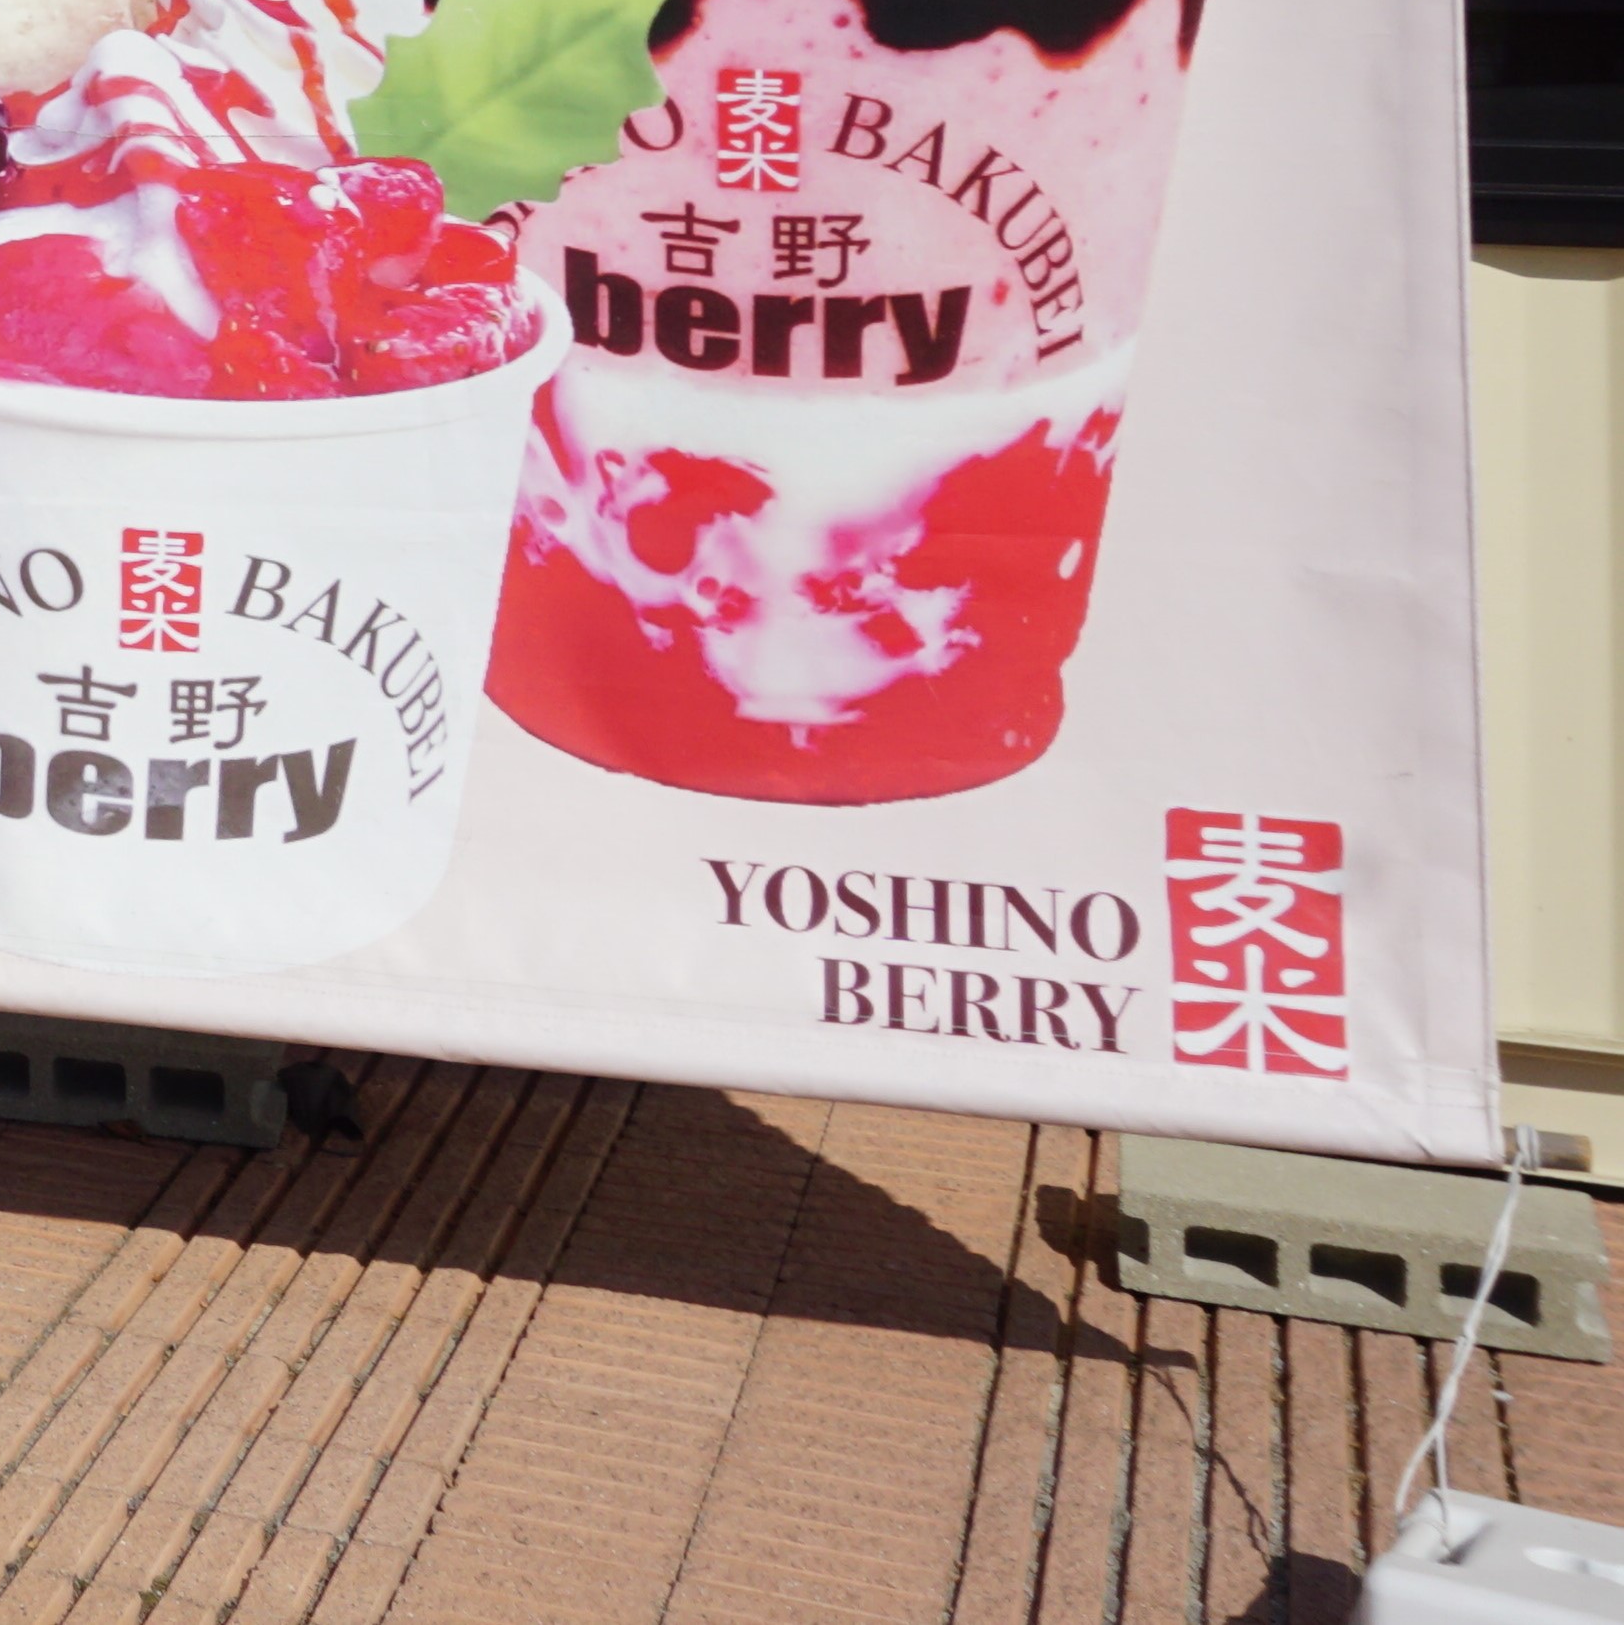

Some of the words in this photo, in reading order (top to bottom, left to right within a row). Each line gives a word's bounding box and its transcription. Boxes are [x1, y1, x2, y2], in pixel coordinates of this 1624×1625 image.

[716, 69, 801, 192] 麦米
[641, 202, 870, 288] 吉野
[827, 93, 1088, 362] BAKUBEI
[564, 246, 973, 386] berry
[119, 527, 203, 653] 麦米
[36, 664, 268, 750] 吉野
[225, 554, 448, 804] BAKUBEI
[701, 857, 1140, 962] YOSHINO
[1163, 807, 1349, 1081] 麦米
[817, 956, 1143, 1054] BERRY
